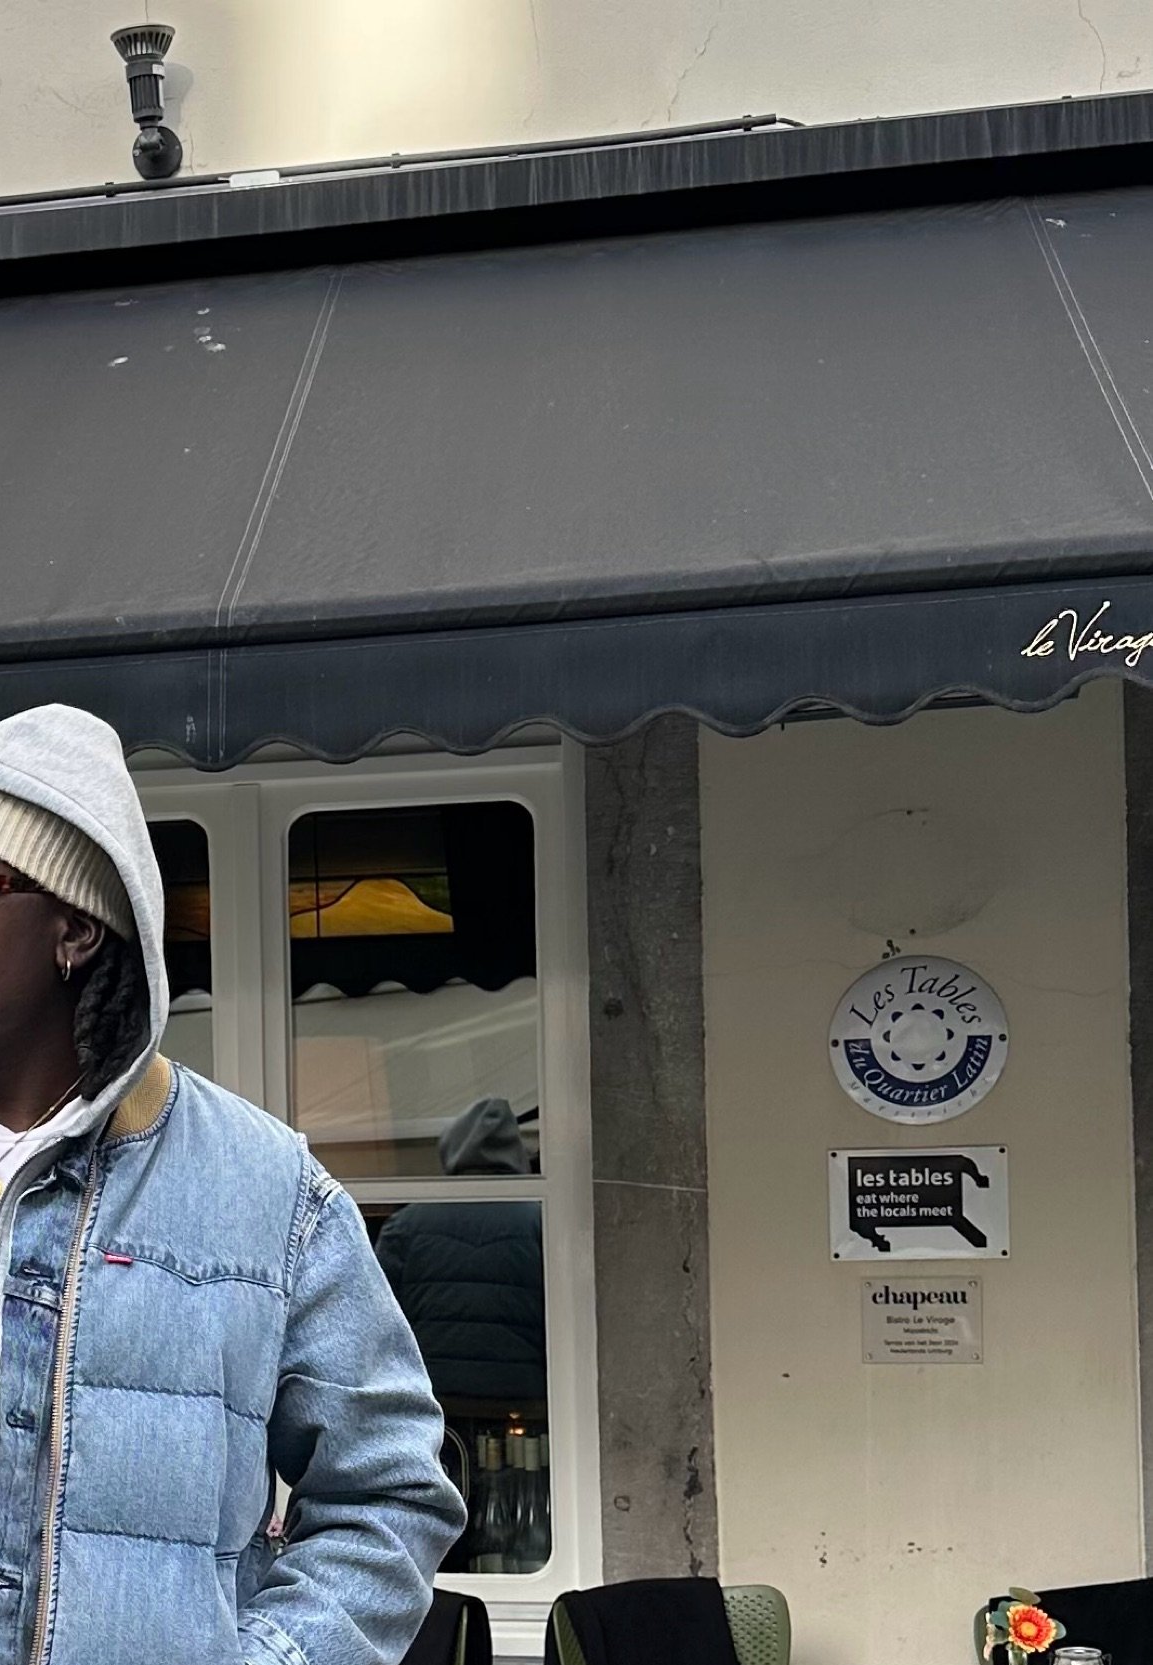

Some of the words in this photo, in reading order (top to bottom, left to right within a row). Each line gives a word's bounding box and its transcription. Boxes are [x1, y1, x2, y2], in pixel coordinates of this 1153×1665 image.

[1020, 618, 1059, 657] le
[849, 983, 896, 1028] Les
[900, 965, 982, 1025] Tables
[849, 1042, 871, 1069] du
[863, 1068, 948, 1103] Quartier
[951, 1037, 988, 1089] Latin
[856, 1168, 885, 1187] les
[889, 1167, 954, 1186] tables
[856, 1193, 877, 1204] eat
[879, 1191, 919, 1204] where
[856, 1205, 878, 1218] the
[880, 1204, 917, 1217] locals
[919, 1205, 953, 1217] meet
[872, 1285, 968, 1311] chapeau
